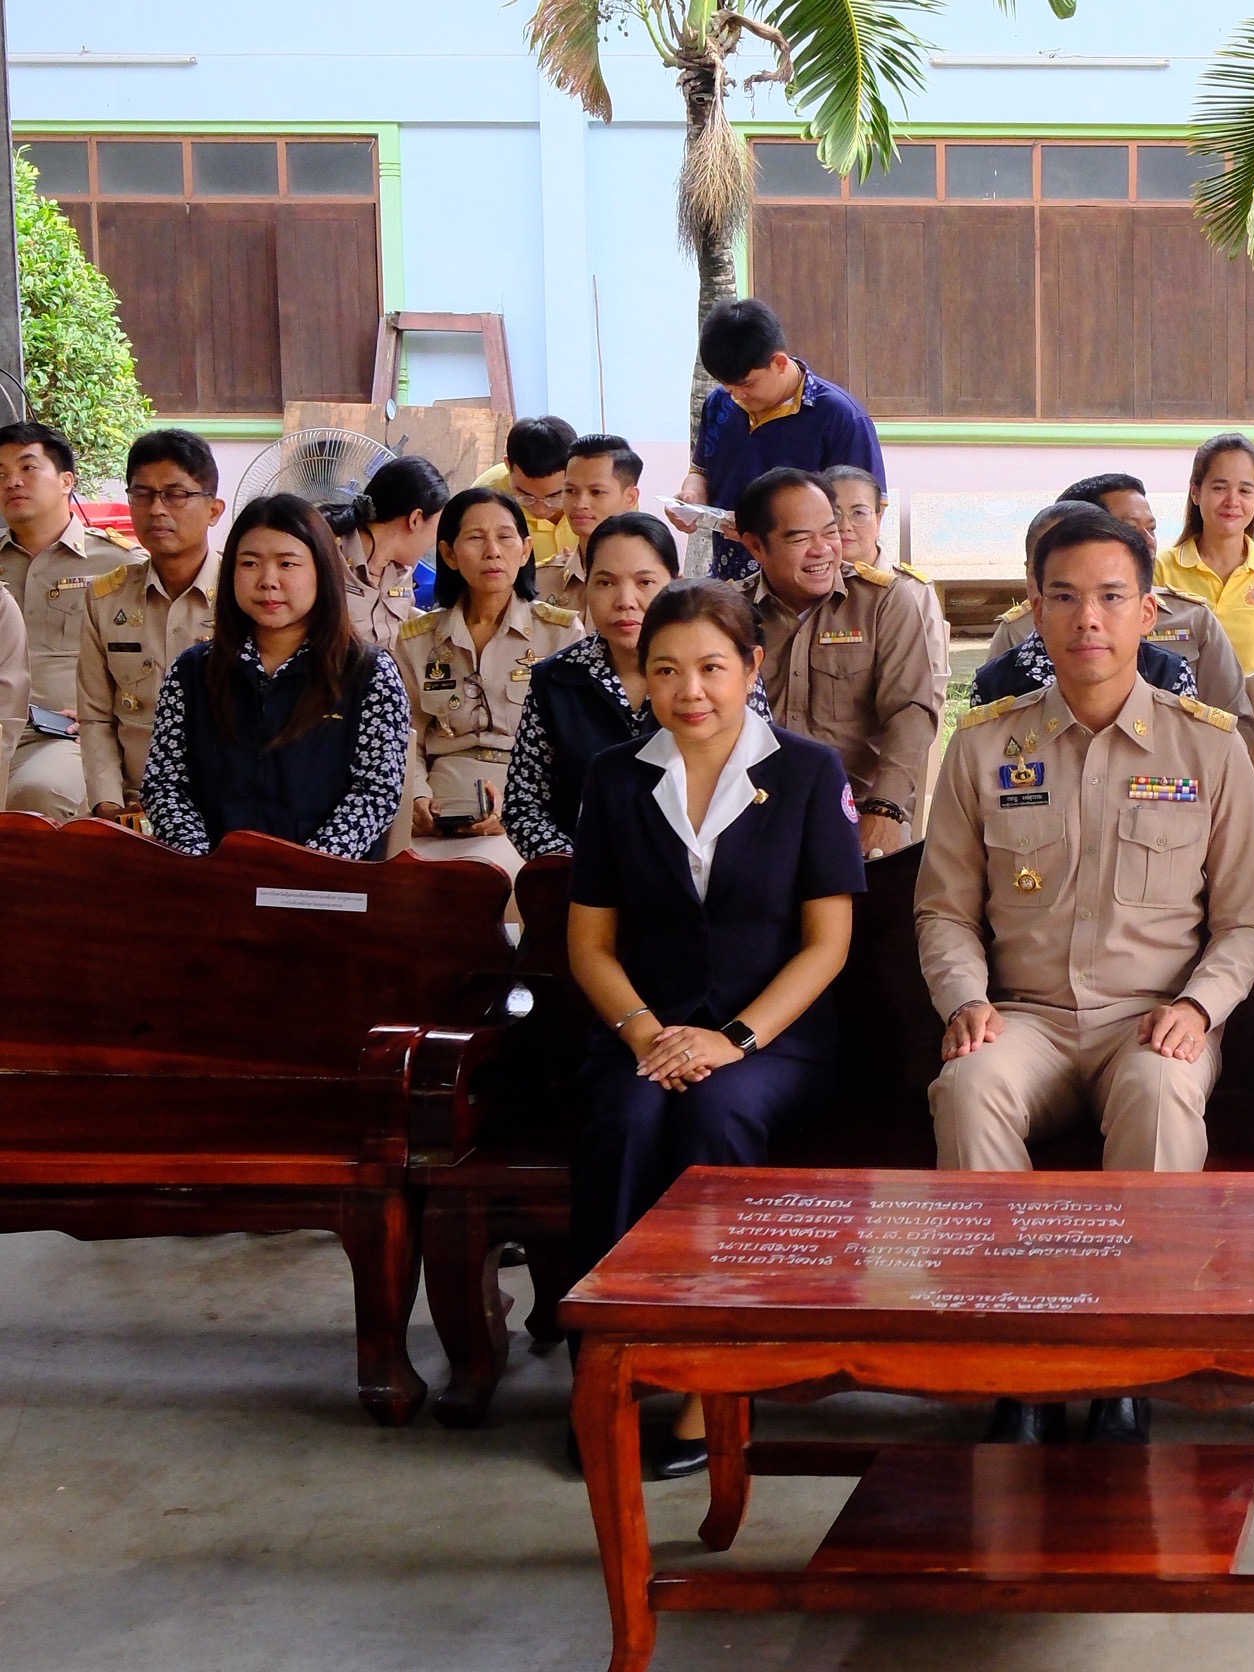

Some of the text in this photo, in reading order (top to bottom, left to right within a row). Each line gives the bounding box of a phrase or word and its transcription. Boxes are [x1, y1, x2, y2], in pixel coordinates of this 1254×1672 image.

[744, 1193, 853, 1210] นายโสภณ
[869, 1199, 984, 1212] นางกฤษณา
[736, 1212, 856, 1225] นายอรรถกร
[865, 1215, 993, 1229] นางเบญจพร
[728, 1225, 841, 1239] นายพงศธร
[717, 1240, 819, 1253] นายสมพร
[710, 1253, 836, 1266] นายอภิวัฒน์
